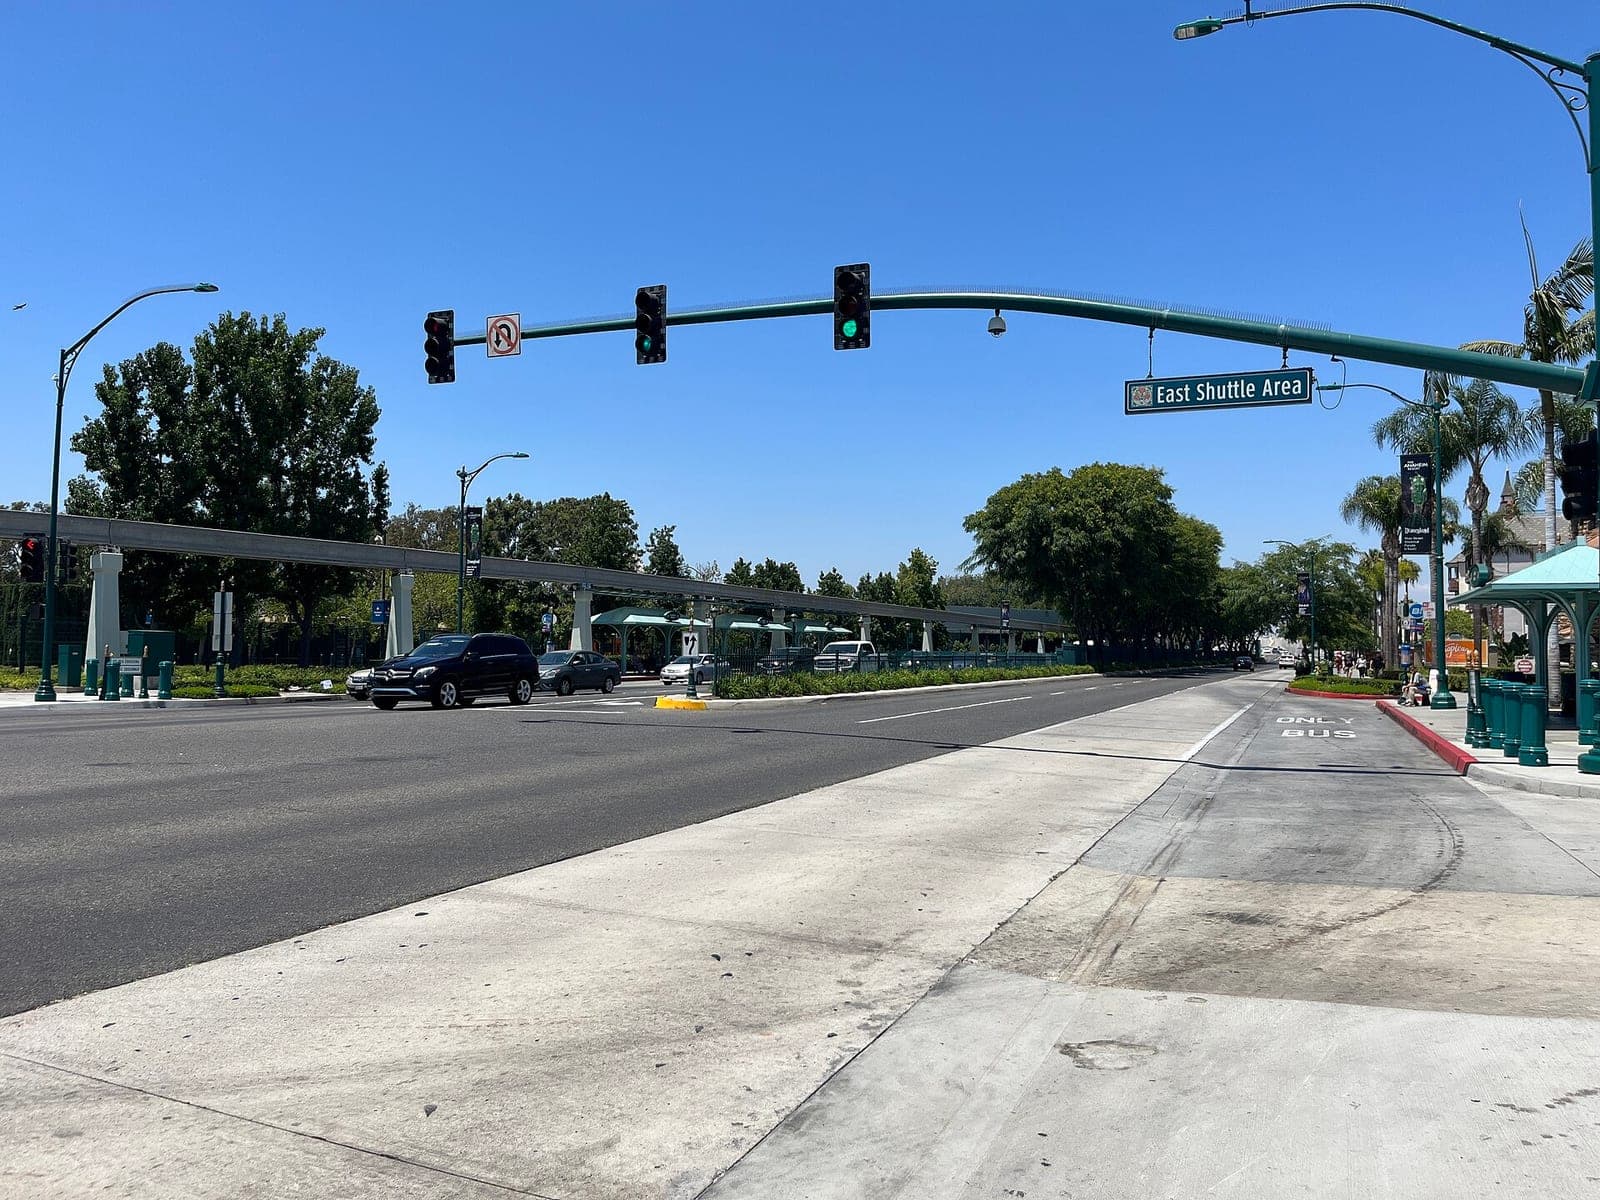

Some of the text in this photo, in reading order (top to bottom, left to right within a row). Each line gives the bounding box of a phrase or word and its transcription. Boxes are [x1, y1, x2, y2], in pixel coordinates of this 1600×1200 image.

[1157, 378, 1302, 404] East Shuttle Area
[1281, 729, 1357, 738] BUS
